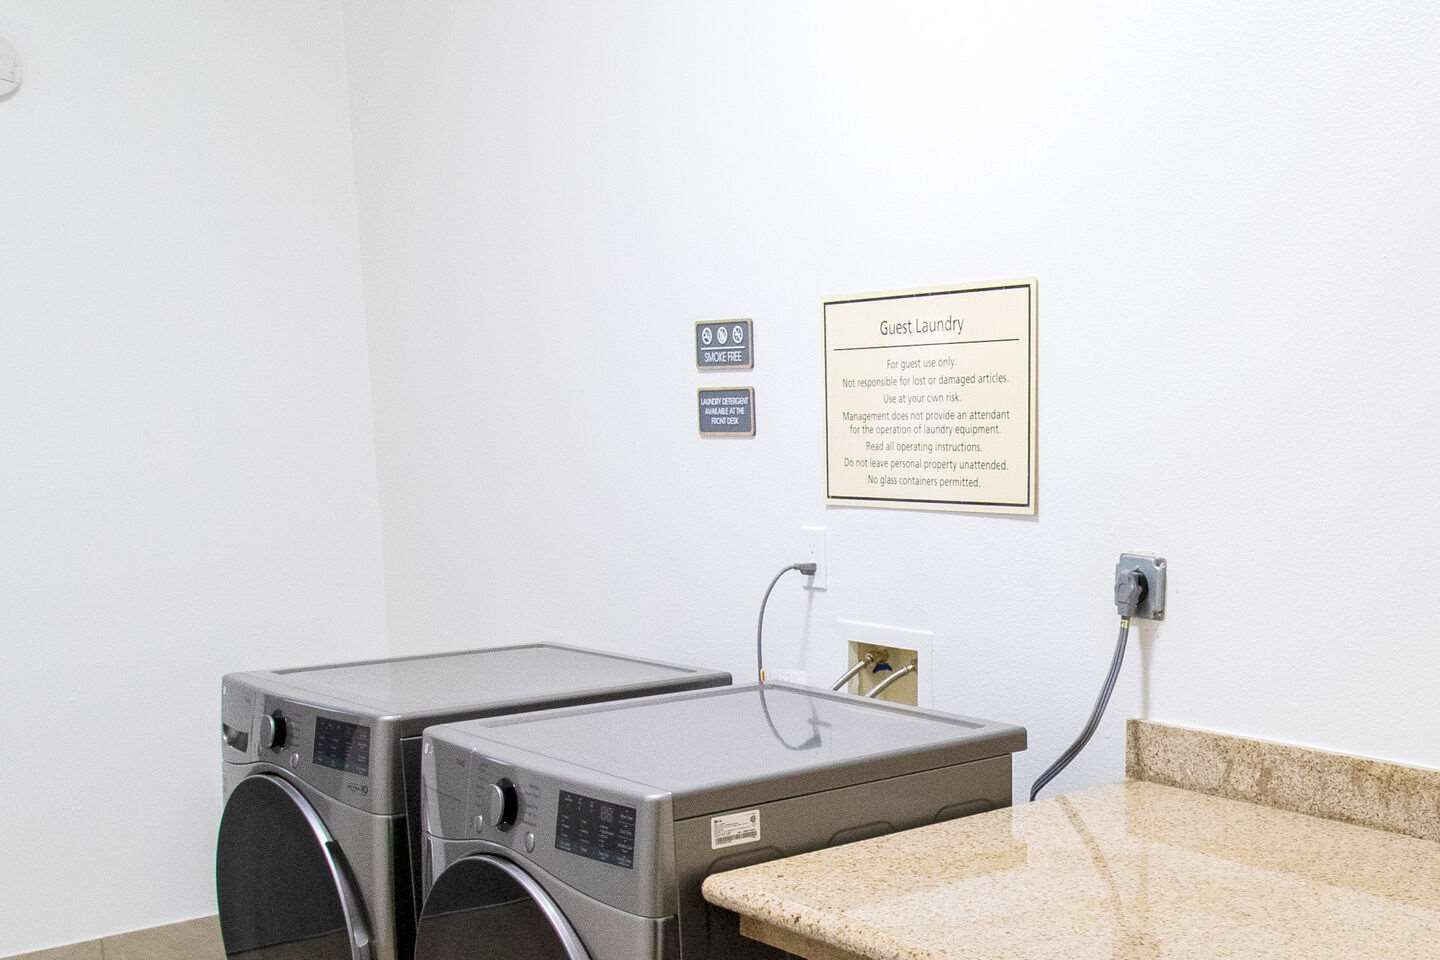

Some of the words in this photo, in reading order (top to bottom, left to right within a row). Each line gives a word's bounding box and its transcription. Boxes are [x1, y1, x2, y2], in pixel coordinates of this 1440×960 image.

[880, 318, 912, 336] Guest
[916, 316, 964, 335] Laundry
[704, 351, 726, 362] SMOKE
[728, 351, 742, 362] FREE
[886, 359, 898, 369] For
[900, 358, 920, 371] guest
[922, 360, 936, 368] use
[842, 378, 856, 388] Not
[857, 376, 898, 389] responsible
[899, 376, 910, 386] for
[912, 375, 926, 386] lost
[928, 377, 936, 386] or
[938, 374, 976, 387] damaged
[978, 372, 1008, 384] articles.
[883, 394, 897, 404] Use
[898, 394, 906, 403] at
[908, 394, 925, 405] your
[927, 394, 944, 402] own
[945, 392, 962, 402] risk.
[842, 411, 890, 423] Management
[892, 412, 909, 421] does
[910, 412, 924, 421] not
[925, 411, 955, 422] provide
[957, 412, 967, 420] an
[969, 410, 1010, 420] attendant
[850, 424, 860, 434] for
[862, 424, 874, 434] the
[876, 424, 912, 435] operation
[914, 424, 922, 434] of
[924, 424, 952, 435] laundry
[955, 425, 1000, 436] equipment.
[866, 442, 884, 451] Read
[885, 442, 895, 451] all
[896, 442, 933, 454] operating
[934, 442, 982, 452] instructions.
[844, 458, 854, 467] Do
[856, 458, 868, 468] not
[870, 458, 888, 468] leave
[890, 458, 922, 470] personal
[924, 460, 957, 472] property
[959, 460, 1008, 470] unattended.
[868, 474, 878, 484] No
[880, 475, 898, 486] glass
[899, 476, 938, 486] containers
[939, 477, 980, 488] permitted.
